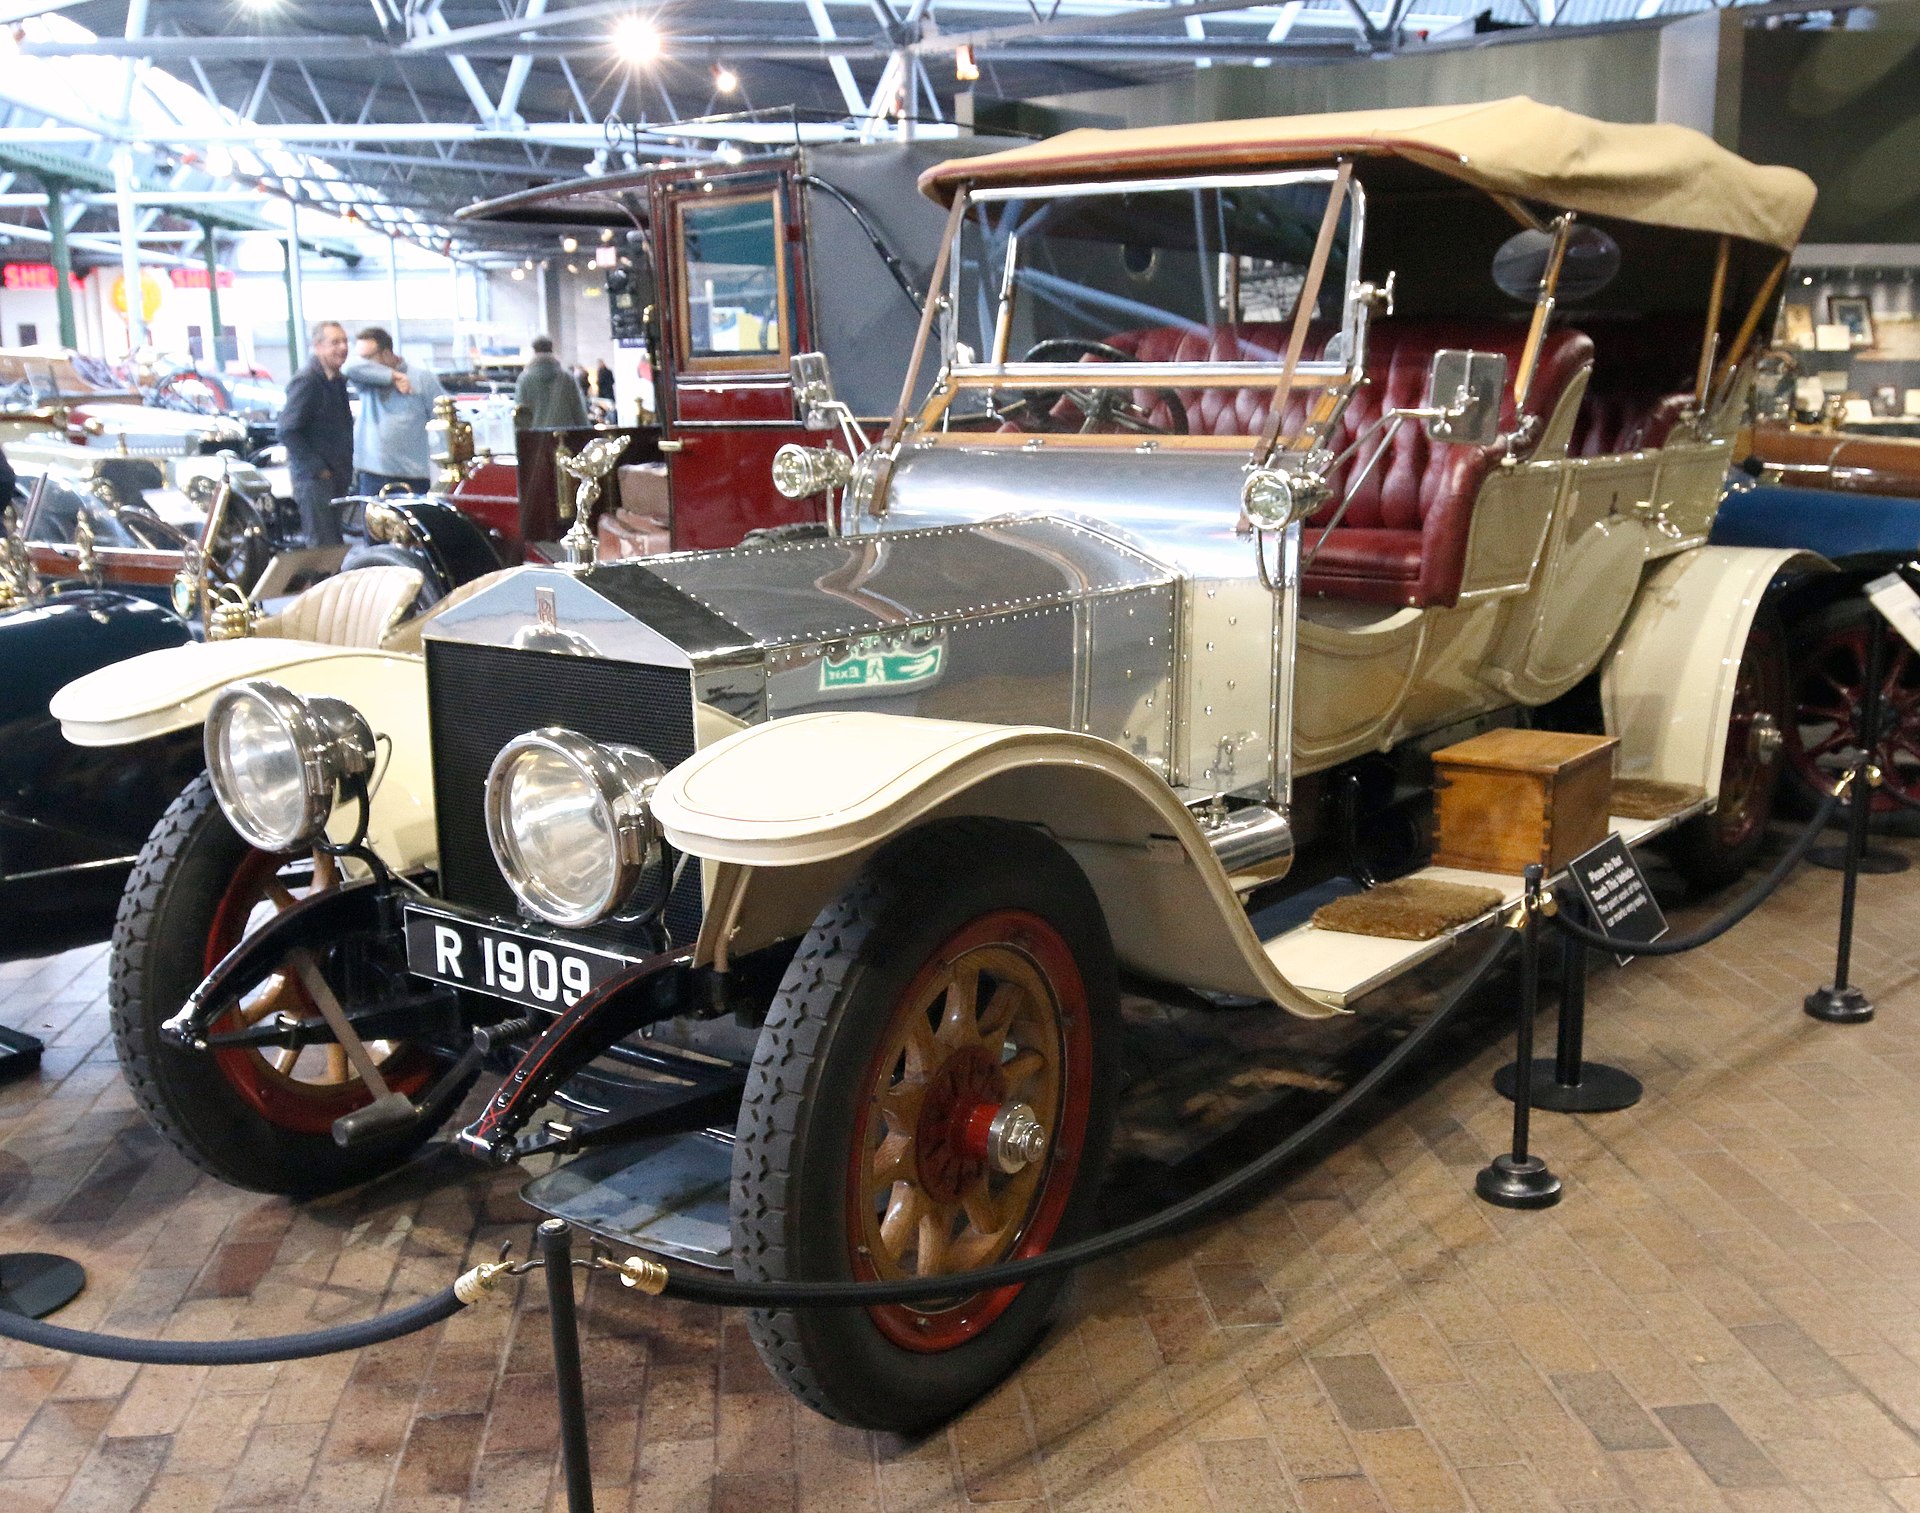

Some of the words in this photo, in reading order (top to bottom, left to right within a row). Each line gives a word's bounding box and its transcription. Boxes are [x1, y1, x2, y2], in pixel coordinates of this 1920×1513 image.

[1588, 868, 1607, 883] Please
[1603, 862, 1614, 874] Do
[1611, 855, 1624, 868] Not
[1591, 884, 1609, 901] Touch
[1615, 867, 1635, 884] Vehicle
[435, 925, 464, 978] R
[483, 936, 590, 1008] 1909
